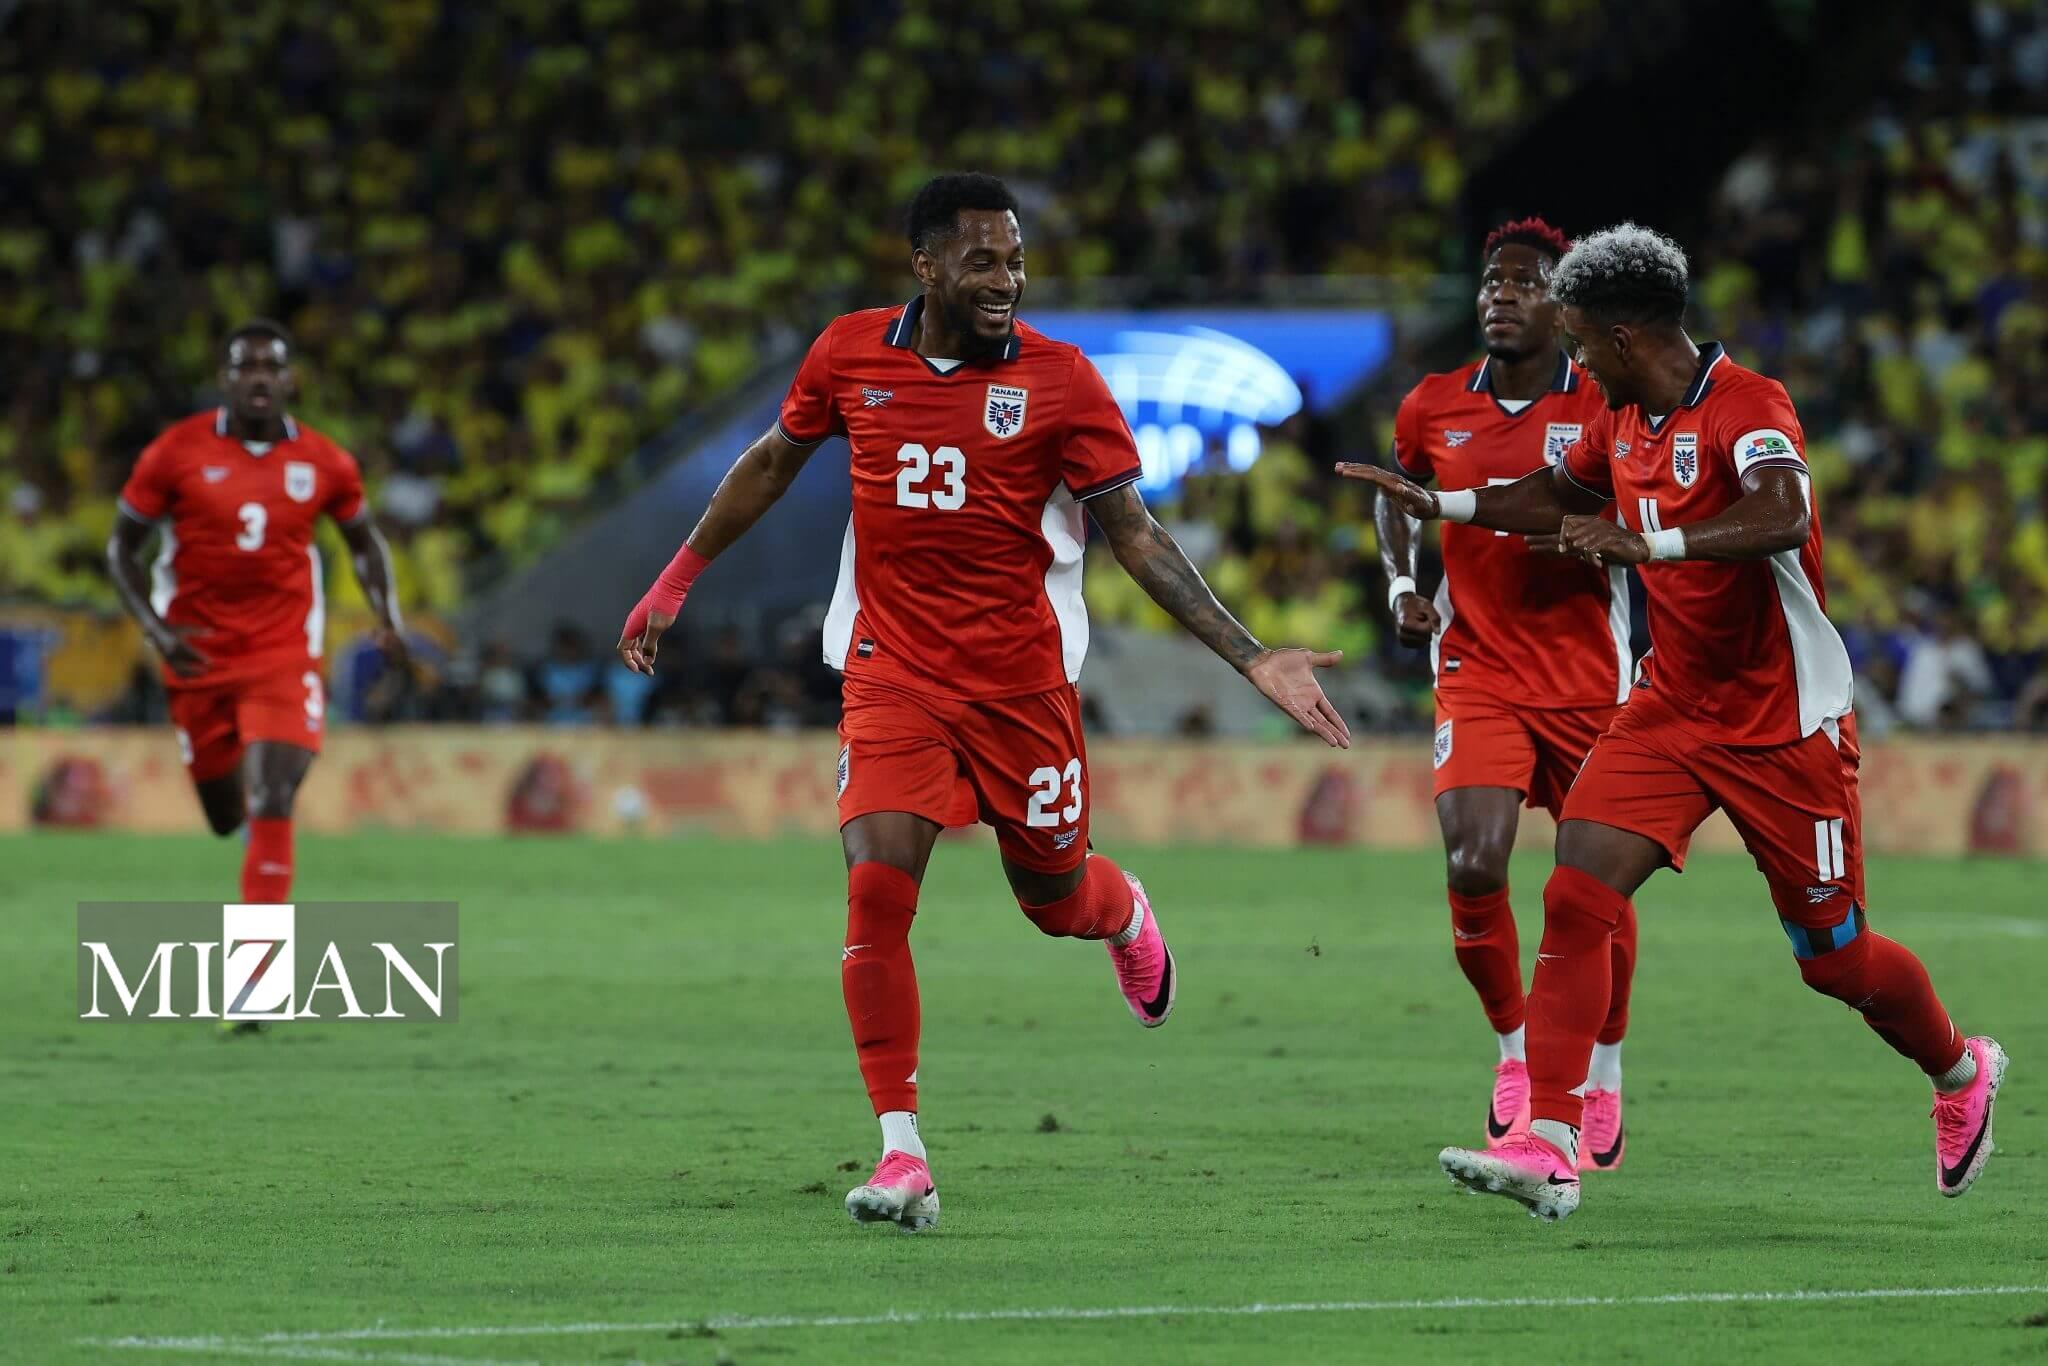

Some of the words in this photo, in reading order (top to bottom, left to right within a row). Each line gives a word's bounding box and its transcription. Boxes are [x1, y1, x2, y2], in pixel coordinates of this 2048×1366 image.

[862, 388, 893, 398] Reebok
[991, 387, 1024, 398] PANAMA
[897, 443, 966, 511] 23
[236, 501, 267, 552] 3
[302, 671, 324, 720] 3
[1026, 757, 1082, 827] 23
[1814, 817, 1845, 882] 11
[1806, 886, 1840, 895] Reebok
